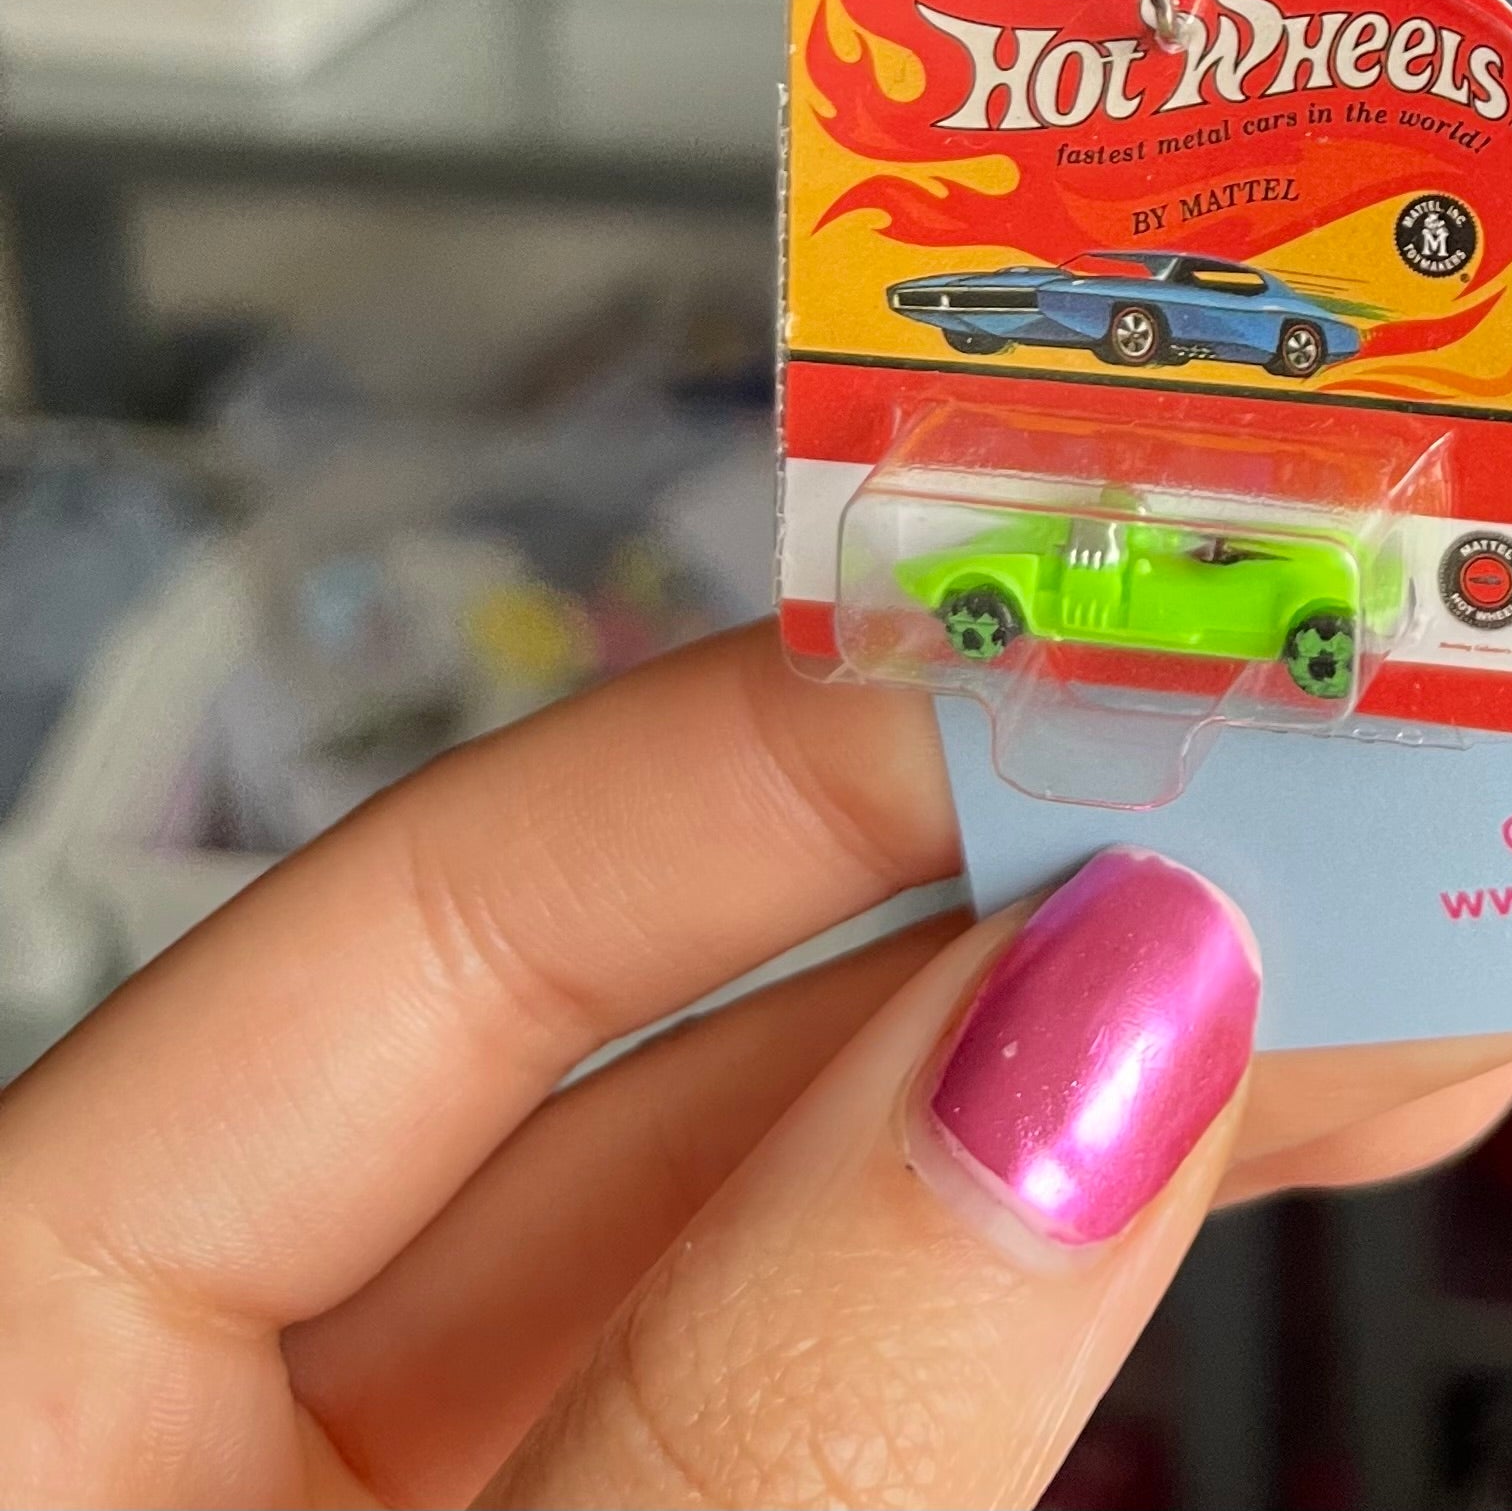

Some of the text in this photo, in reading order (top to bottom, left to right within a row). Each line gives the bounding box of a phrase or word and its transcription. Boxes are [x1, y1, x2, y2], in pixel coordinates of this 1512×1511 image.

[1056, 101, 1492, 167] fastest metal cars in the world!
[1132, 178, 1300, 236] BY MATTEL
[1450, 592, 1477, 616] HOT
